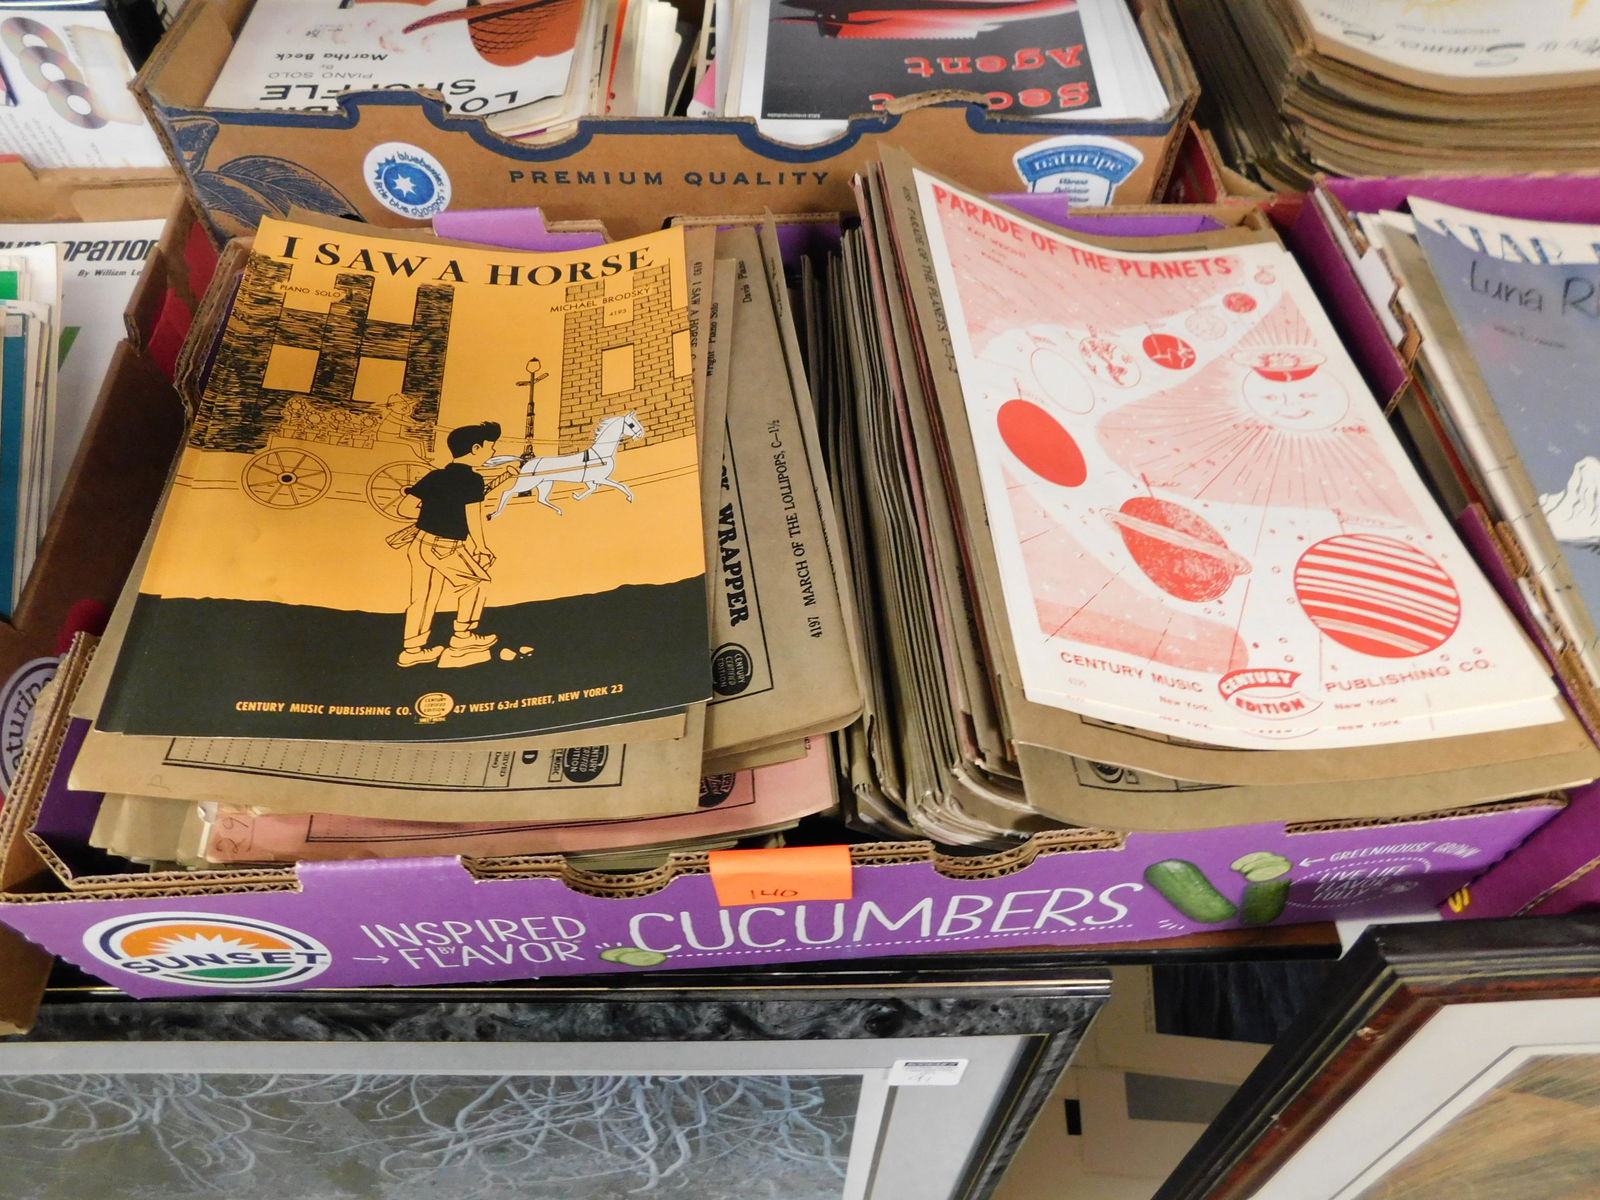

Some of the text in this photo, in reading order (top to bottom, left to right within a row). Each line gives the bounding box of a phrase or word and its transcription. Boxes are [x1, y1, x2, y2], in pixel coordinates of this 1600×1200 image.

[274, 52, 388, 62] Martha Beck
[905, 44, 1084, 78] Agent
[509, 170, 832, 186] PREMIUM QUALITY
[931, 182, 1025, 244] PARADE
[1029, 228, 1061, 255] OF
[1066, 245, 1113, 276] THE
[1121, 255, 1233, 281] PLANETS
[280, 234, 654, 288] I SAW A HORSE
[917, 247, 930, 263] OF
[77, 269, 90, 278] By
[94, 268, 127, 277] William
[920, 264, 935, 286] THE
[279, 283, 341, 299] PIANO SOLO
[550, 286, 651, 314] MICHAEL BRODSKY
[1470, 261, 1544, 314] Luna
[927, 286, 947, 333] PLANETS
[773, 450, 797, 510] LOLLIPOPS,
[785, 512, 801, 538] THE
[791, 540, 806, 558] OF
[717, 503, 750, 627] WRAPPER
[795, 559, 817, 607] MARCH
[808, 616, 823, 639] 4197
[1060, 651, 1204, 693] CENTURY MUSIC
[1324, 658, 1496, 693] PUBLISHING CO.
[236, 683, 624, 717] CENTURY MUSIC PUBLISHING CO. 47 WEST 63rd STREET, NEW YORK 23
[1234, 696, 1307, 715] EDITION
[551, 756, 562, 776] MUSIC
[569, 747, 580, 773] DITION
[587, 746, 600, 773] ENTURY
[1329, 842, 1436, 862] GREENHOUSE
[1318, 864, 1412, 883] LIVE LIFE
[628, 883, 1145, 953] CUCUMBERS
[360, 916, 587, 948] INSPIRED
[122, 949, 329, 975] SUNSET
[397, 940, 575, 970] FLAVOR
[437, 946, 457, 955] BY
